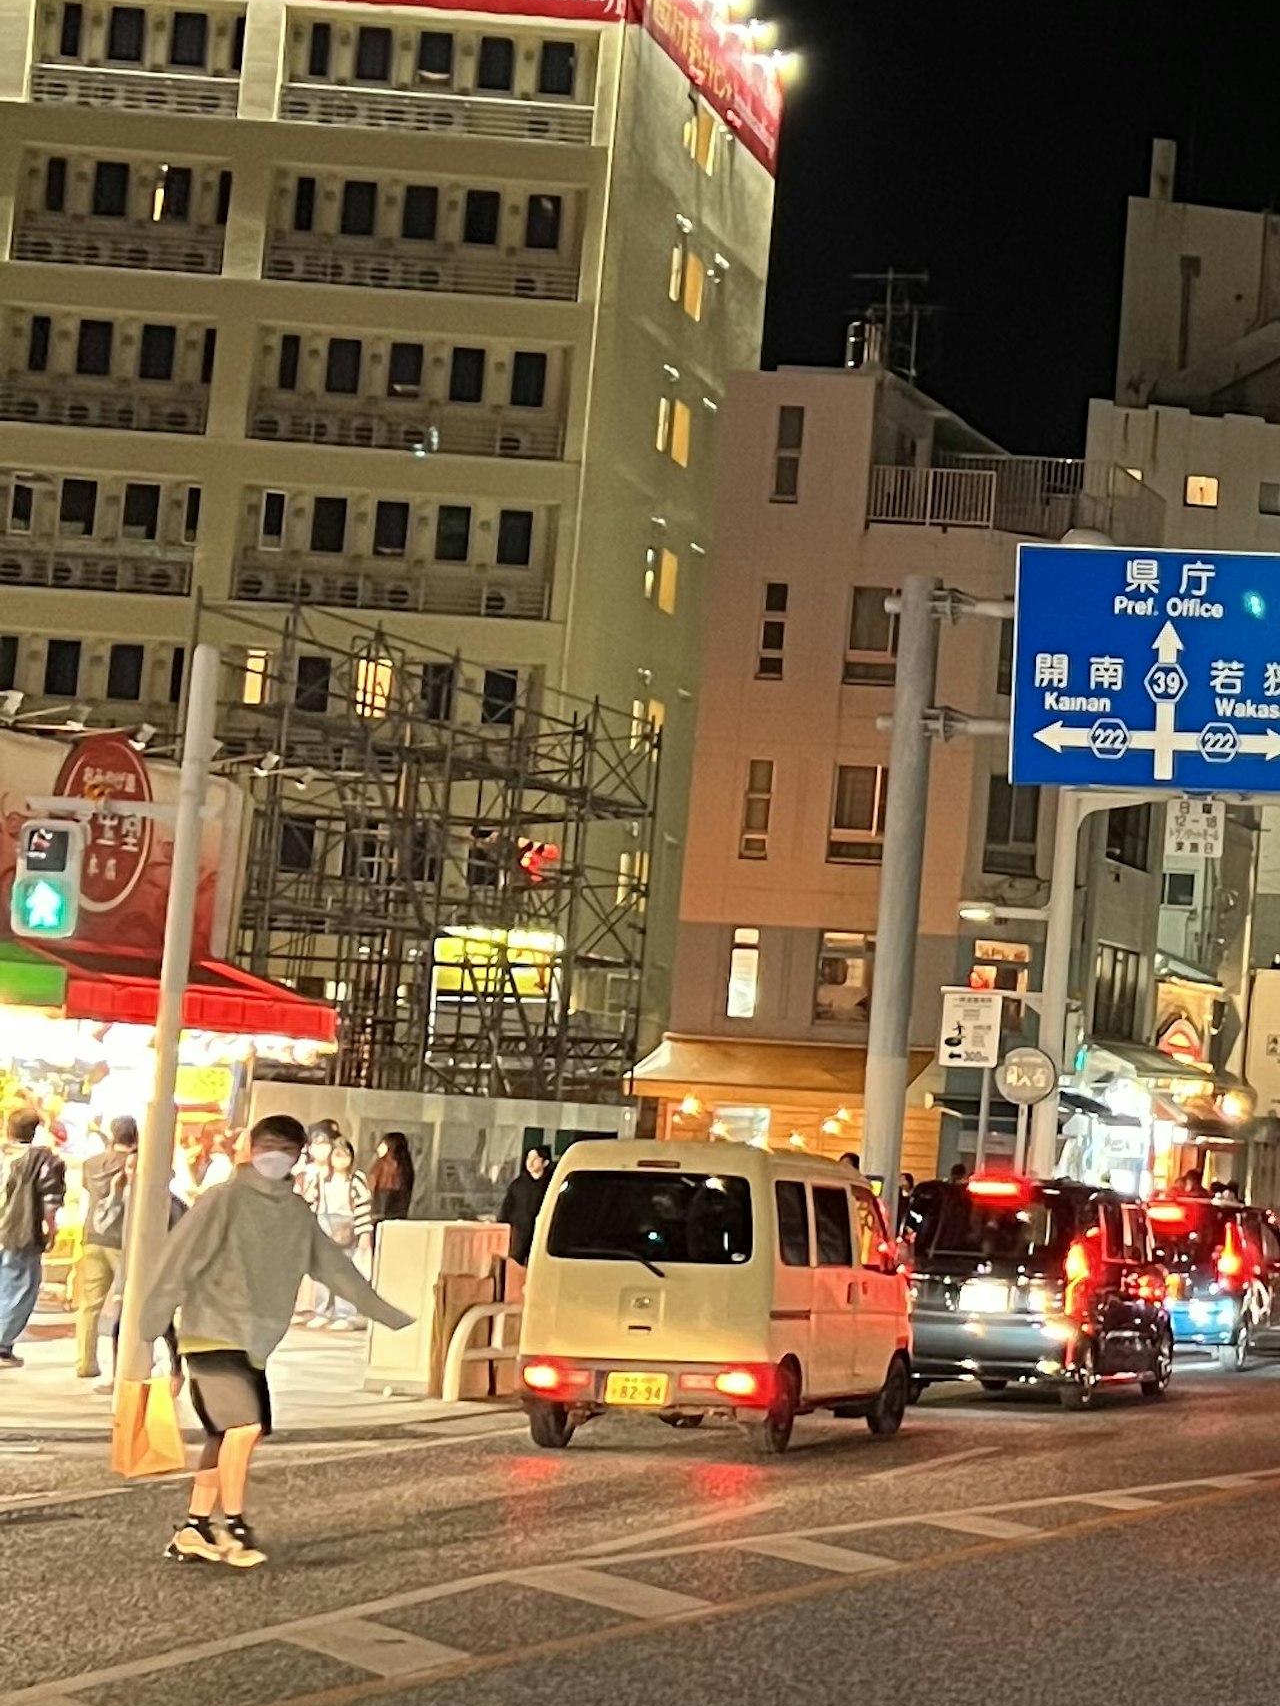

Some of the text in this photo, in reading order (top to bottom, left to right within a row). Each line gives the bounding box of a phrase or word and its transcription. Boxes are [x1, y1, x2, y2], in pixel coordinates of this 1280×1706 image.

[1125, 559, 1216, 596] 県庁
[1114, 595, 1224, 619] Pref. Office
[1034, 653, 1124, 691] 開南
[1152, 671, 1179, 694] 39
[1044, 691, 1111, 713] Kainan
[1094, 727, 1124, 748] 222
[1204, 731, 1234, 753] 222
